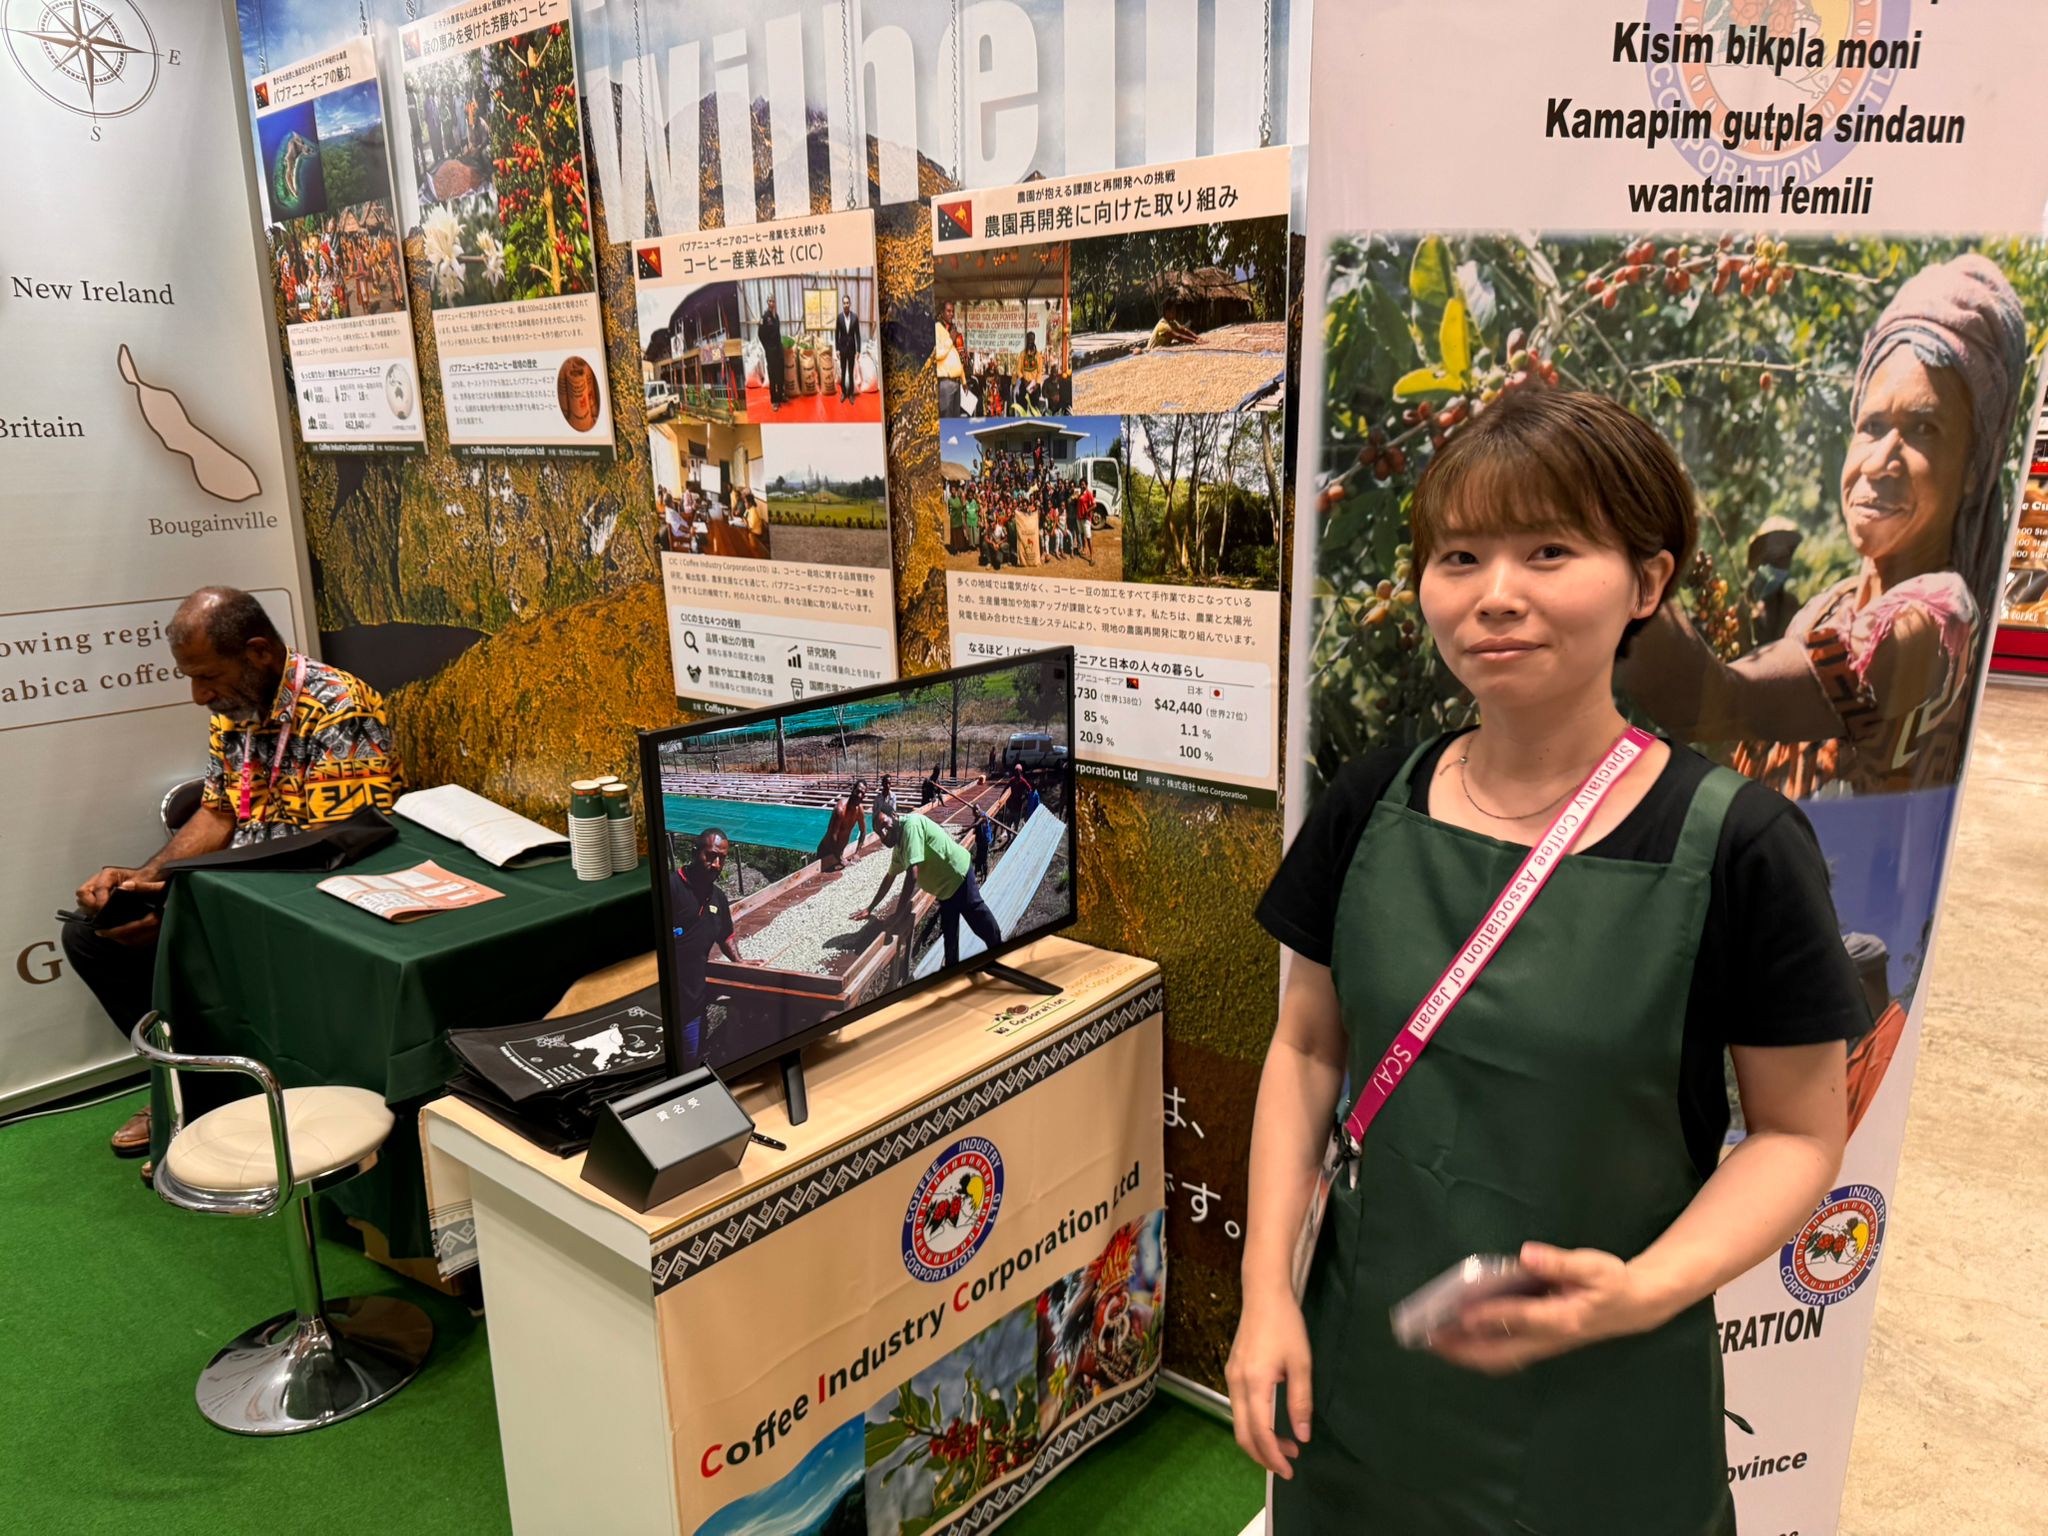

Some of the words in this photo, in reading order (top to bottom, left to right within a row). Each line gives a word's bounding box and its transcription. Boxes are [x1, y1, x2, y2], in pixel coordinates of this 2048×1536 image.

[168, 49, 182, 66] E
[1612, 22, 1713, 64] Kisim
[1725, 24, 1823, 77] bikpla
[1836, 31, 1922, 69] moni
[90, 126, 102, 142] S
[1545, 98, 1711, 150] Kamapim
[1723, 102, 1823, 151] gutpla
[1834, 104, 1965, 144] sindaun
[1017, 169, 1176, 205] 農園が抱える課題と再開発への挑戦
[1628, 176, 1770, 213] wantaim
[1780, 177, 1873, 214] femili
[984, 184, 1239, 239] 農園再開発に向けた取り組み
[11, 277, 73, 300] New
[80, 280, 176, 305] Ireland
[149, 511, 279, 537] Bougainville
[2, 676, 88, 703] abica
[1187, 685, 1203, 696] 日本
[704, 703, 725, 715] Coffee
[1083, 710, 1097, 723] 85
[1154, 698, 1202, 715] $42,440
[1079, 730, 1103, 744] 20.9
[1181, 723, 1199, 737] 1.1
[1179, 745, 1201, 759] 100
[1122, 770, 1138, 782] Ltd
[1209, 787, 1248, 801] Corporation
[1574, 745, 1634, 811] Specialty
[1534, 813, 1580, 867] Coffee
[1463, 869, 1538, 964] Association
[16, 941, 63, 985] G
[1448, 967, 1466, 989] of
[1412, 986, 1452, 1033] Japan
[1372, 1044, 1413, 1096] SCAJ
[958, 1138, 1001, 1169] INDUSTRY
[906, 1160, 941, 1223] COFFEE
[1848, 1186, 1886, 1224] INDUSTRY
[987, 1193, 1002, 1224] LTD
[904, 1249, 976, 1282] CORPORATION
[1780, 1264, 1857, 1307] CORPORATION
[701, 1393, 809, 1478] Coffee
[818, 1302, 946, 1406] Industry
[953, 1200, 1108, 1313] Corporation
